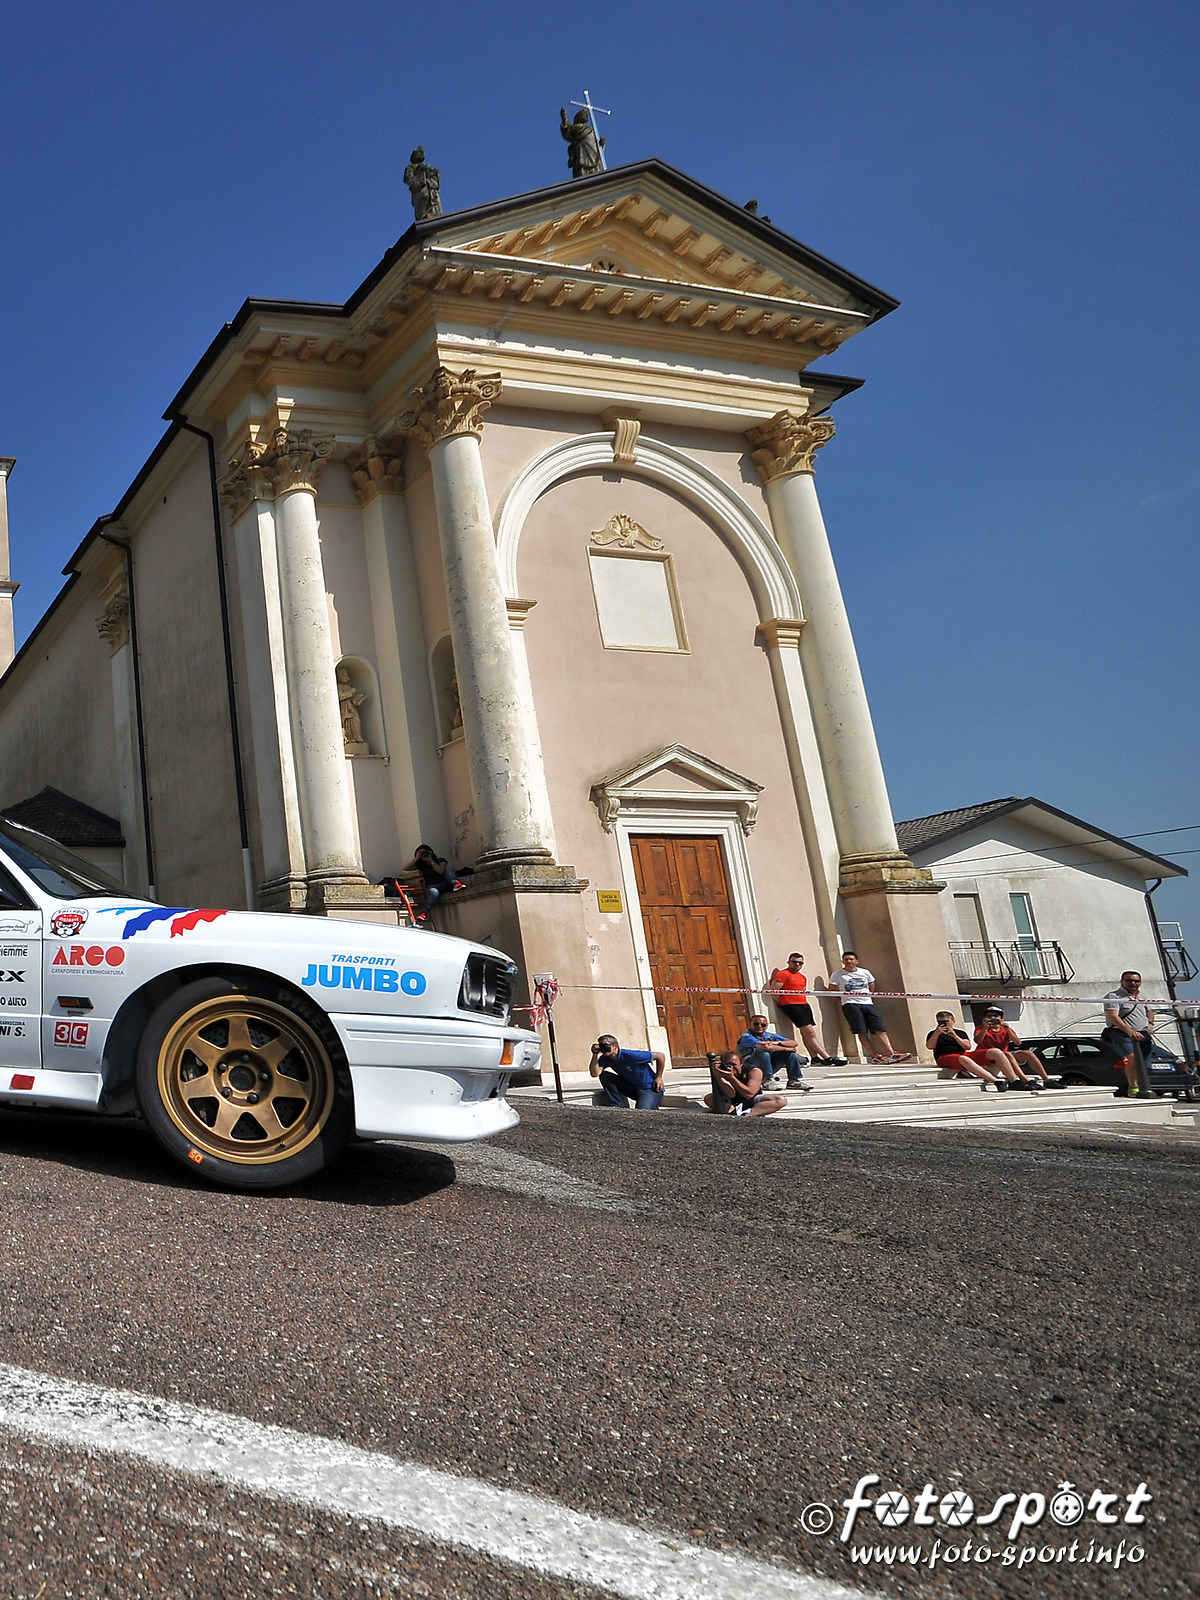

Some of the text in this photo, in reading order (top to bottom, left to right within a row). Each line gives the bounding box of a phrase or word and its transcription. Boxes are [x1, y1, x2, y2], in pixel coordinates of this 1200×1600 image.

[331, 954, 396, 966] TRASPORTI
[301, 963, 427, 996] JUMBO
[7, 997, 27, 1007] AUTO
[14, 1026, 26, 1037] S.
[55, 1024, 87, 1040] 3C
